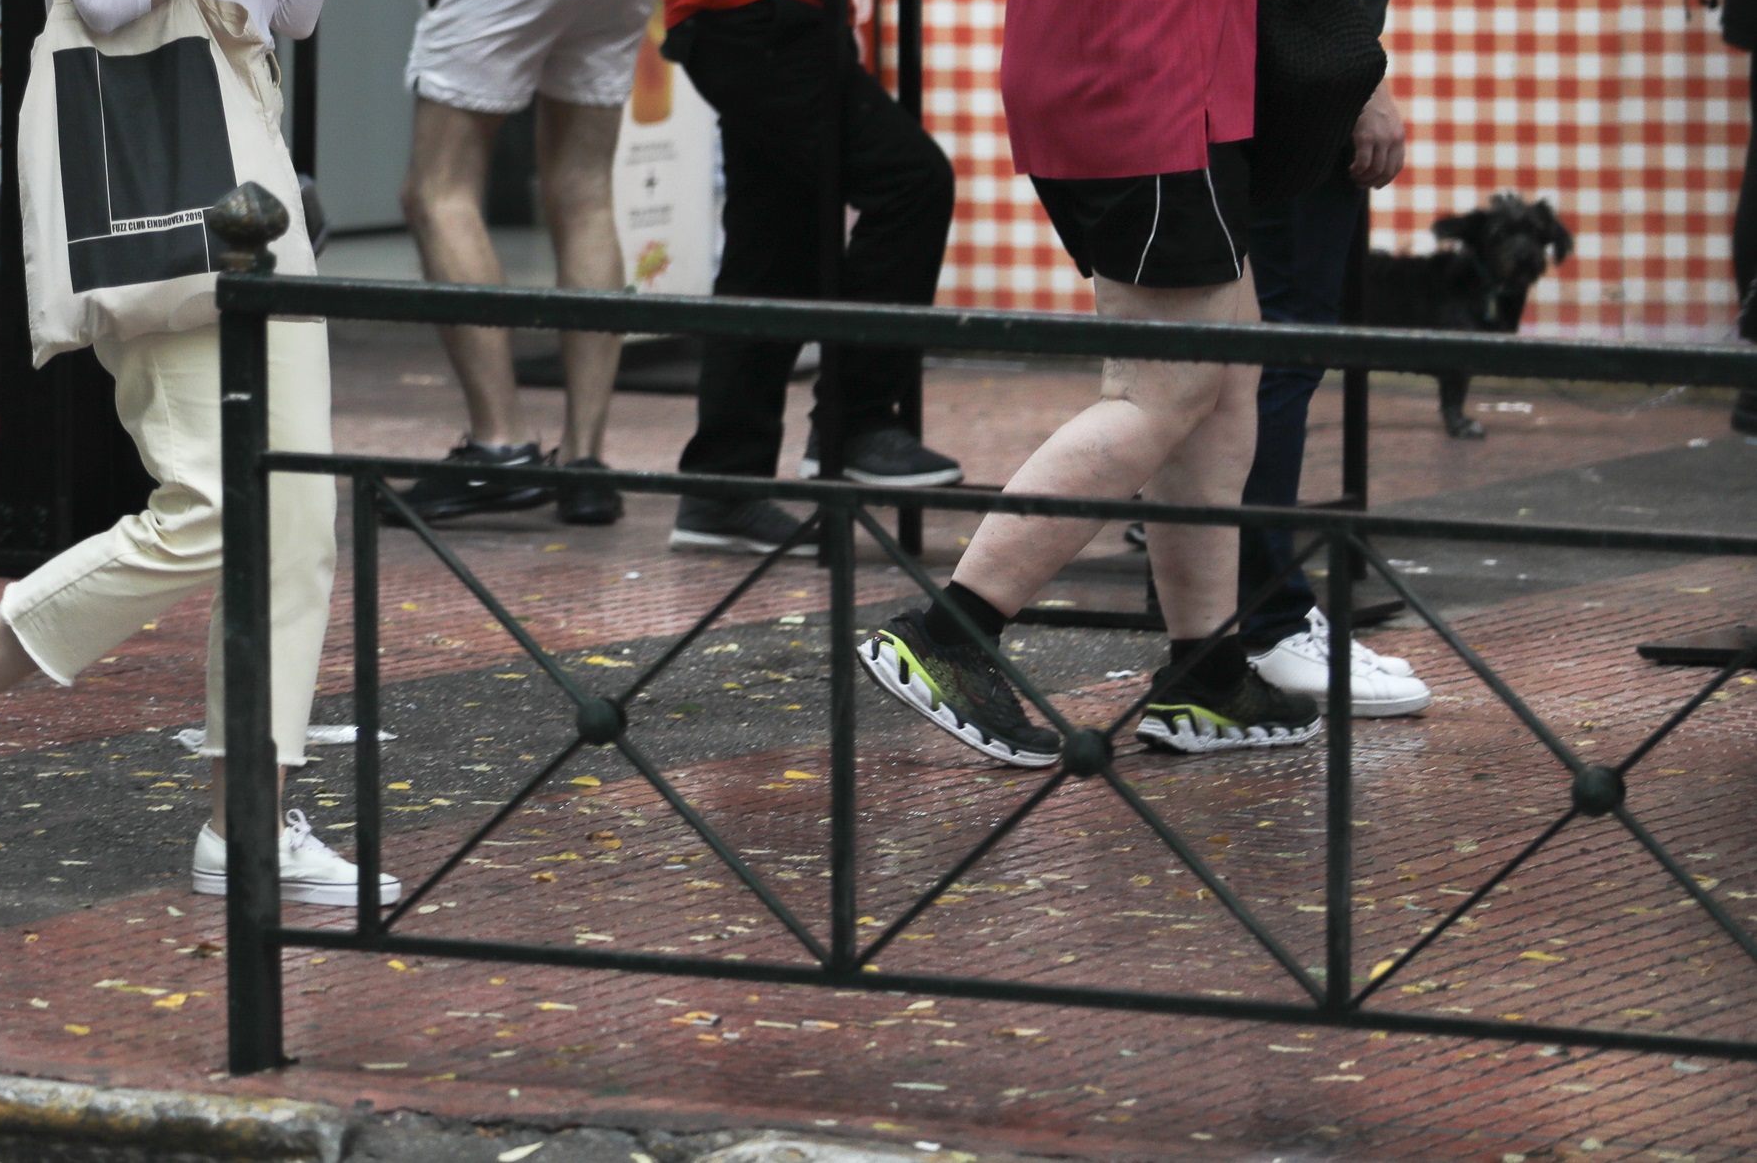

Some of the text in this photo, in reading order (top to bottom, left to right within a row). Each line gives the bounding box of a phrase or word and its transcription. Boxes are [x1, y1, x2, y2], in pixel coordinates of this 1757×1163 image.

[112, 210, 203, 233] FUZZ CLUB EINDHOVEN 2019
